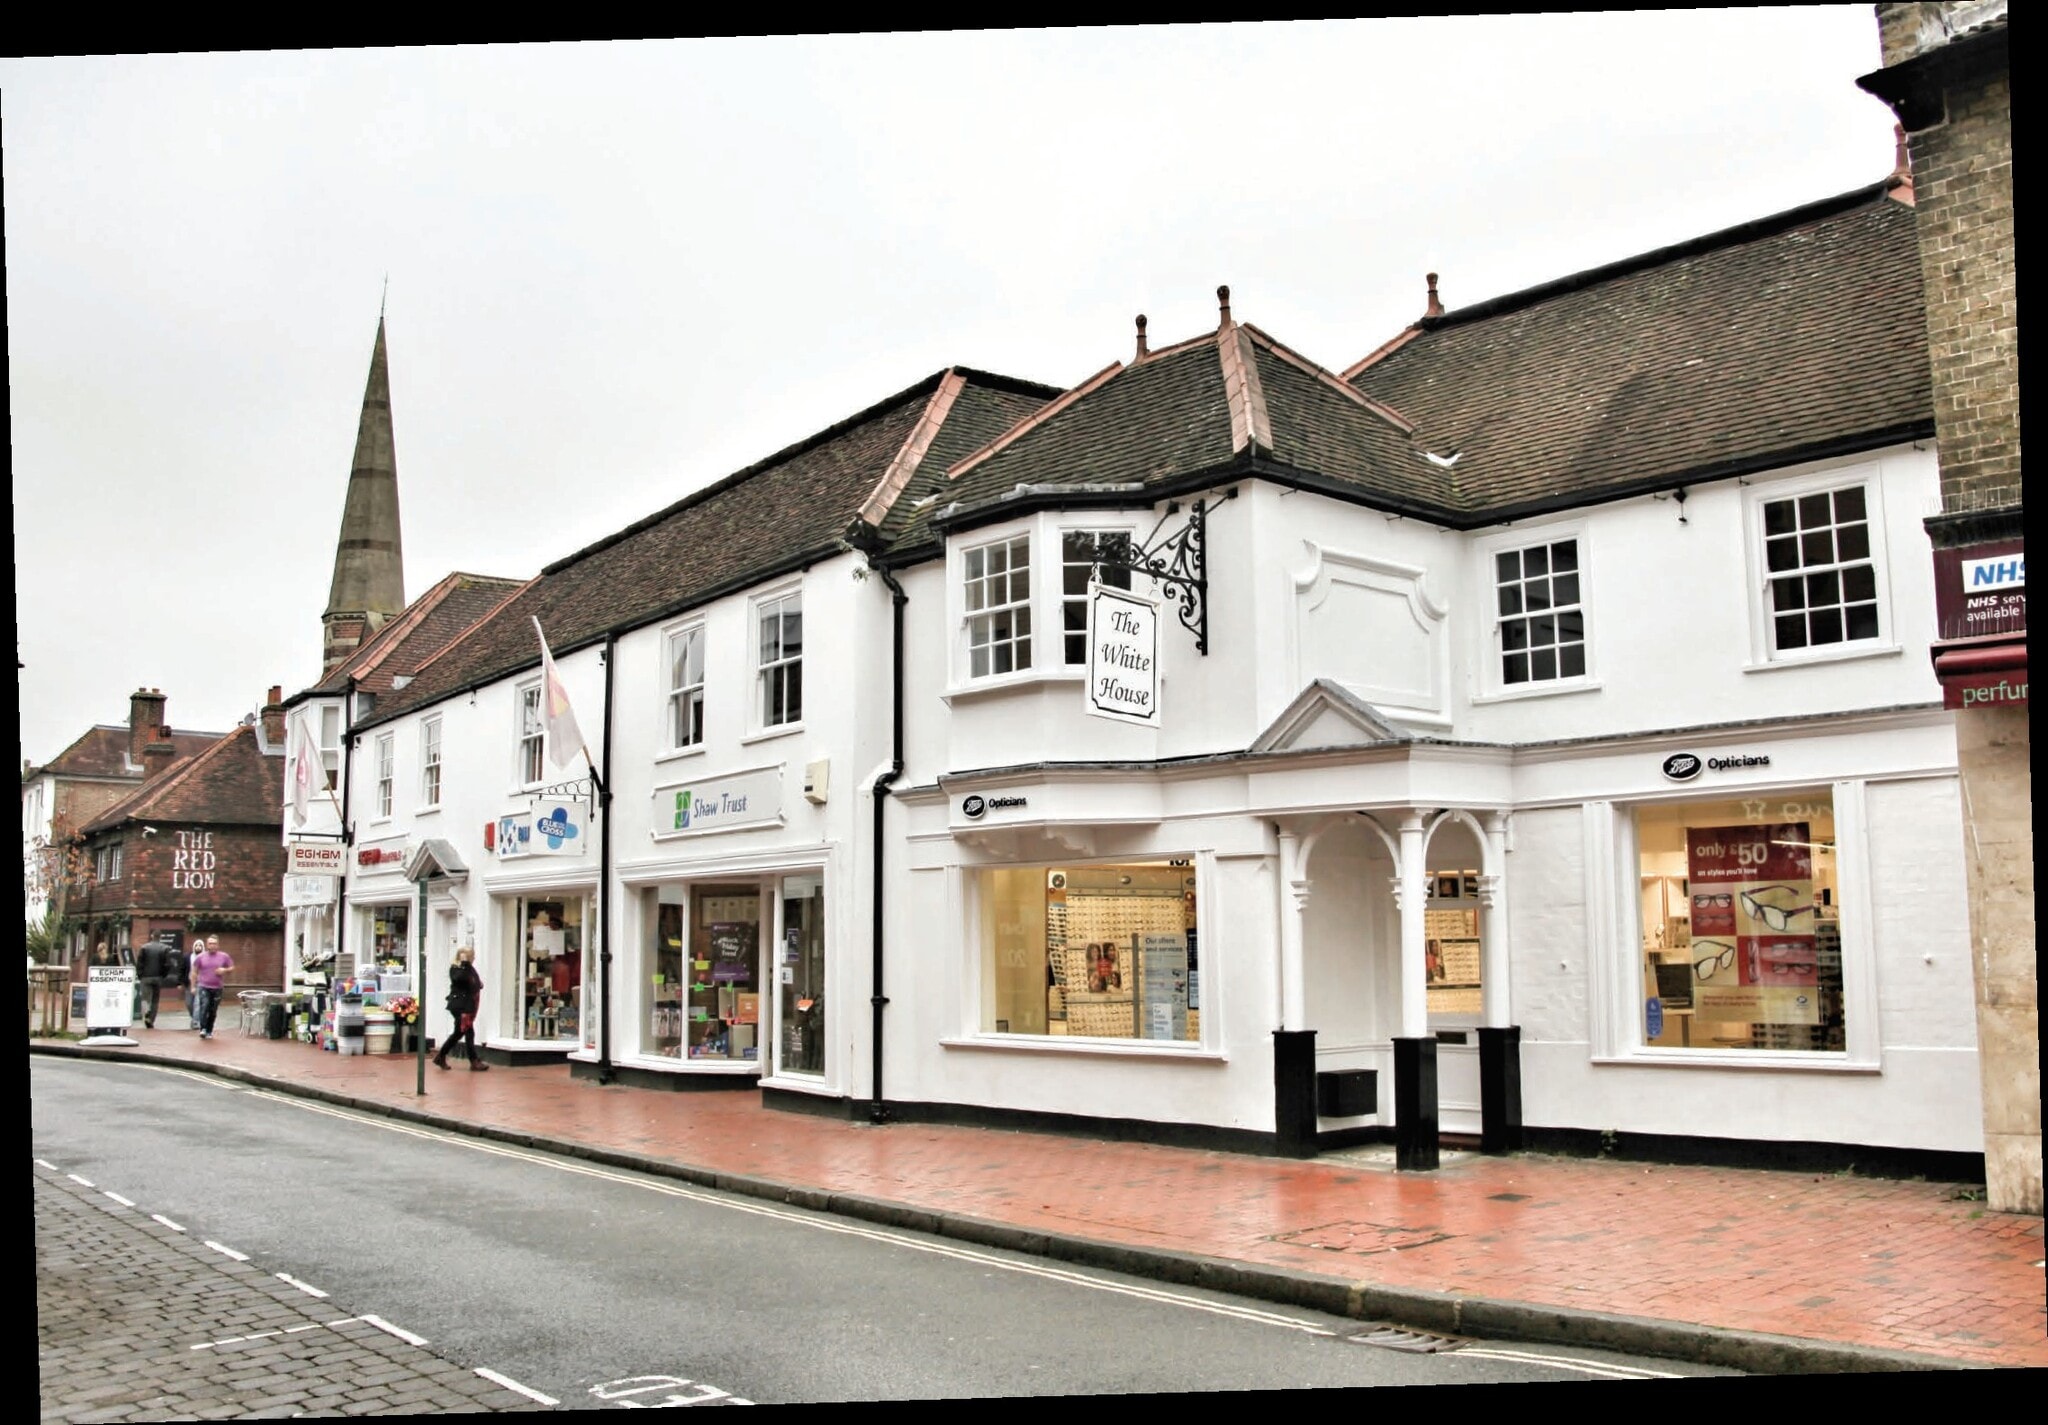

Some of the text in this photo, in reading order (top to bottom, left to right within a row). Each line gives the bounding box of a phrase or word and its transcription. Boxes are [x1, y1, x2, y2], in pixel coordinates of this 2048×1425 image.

[1967, 595, 1999, 609] NHS
[1966, 604, 2021, 622] available
[1111, 611, 1140, 636] The
[1101, 643, 1150, 672] White
[1099, 677, 1150, 706] House
[1707, 754, 1770, 771] Opticians
[694, 792, 747, 819] Shaw Trust
[988, 796, 1027, 809] Opticians
[174, 830, 214, 849] THE
[541, 825, 564, 836] CROSS
[173, 849, 216, 870] RED
[1696, 841, 1768, 865] only £50
[173, 871, 216, 889] LION
